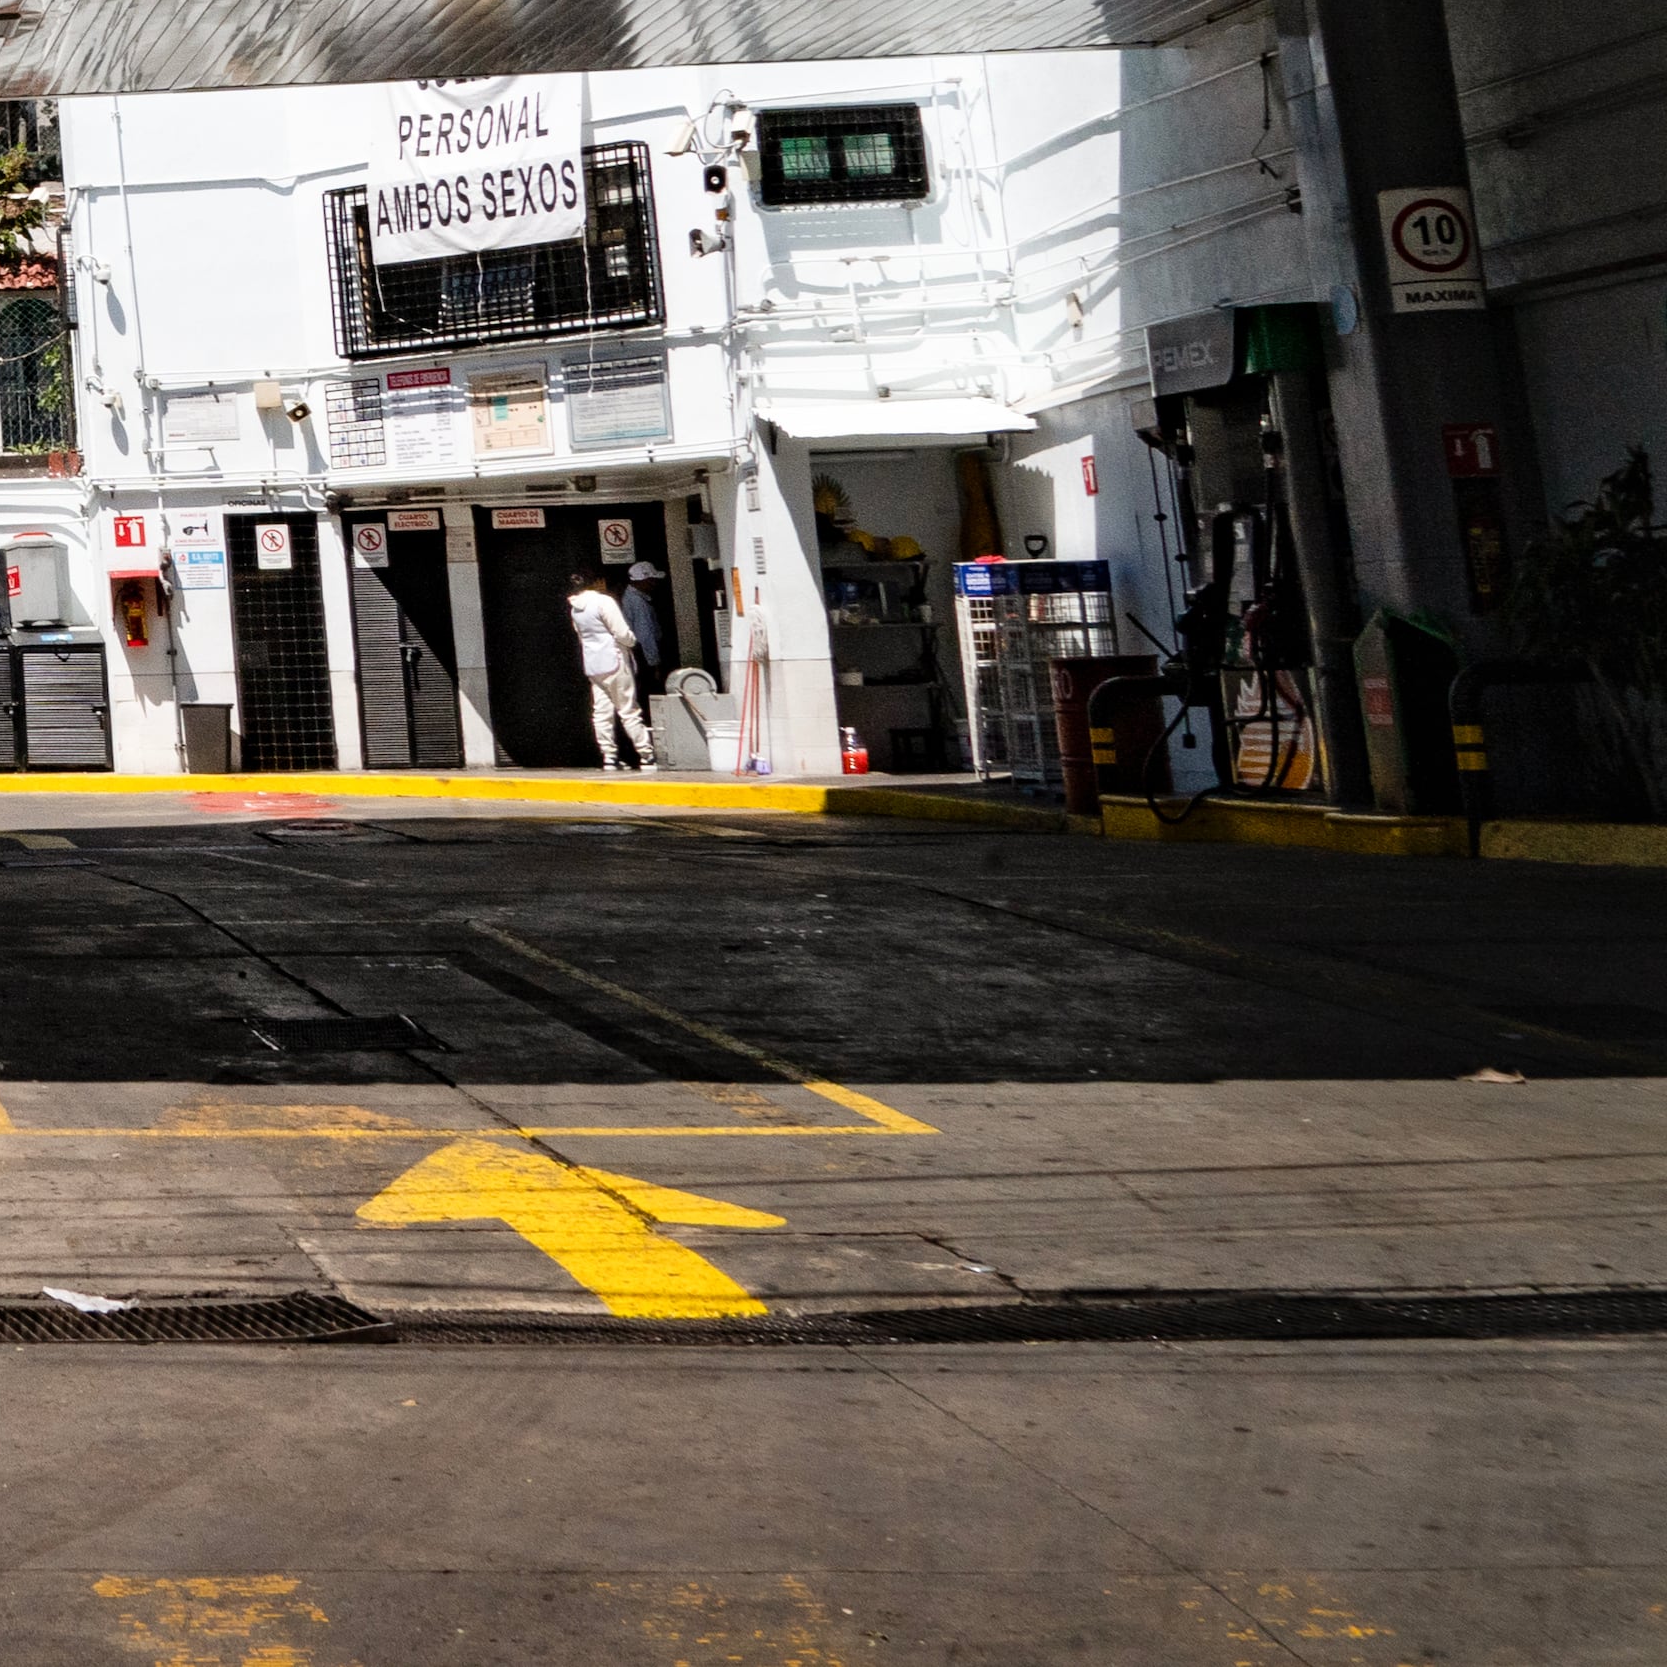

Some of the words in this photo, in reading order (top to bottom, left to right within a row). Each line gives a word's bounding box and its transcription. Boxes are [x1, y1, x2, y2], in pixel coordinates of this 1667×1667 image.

[399, 92, 549, 160] PERSONAL
[377, 175, 472, 236] AMBOS
[482, 159, 577, 221] SEXOS
[1412, 214, 1455, 245] 10
[228, 499, 266, 507] OFICINAS
[398, 513, 429, 521] CUARTO
[496, 511, 527, 519] CUARTO
[529, 510, 539, 518] DE
